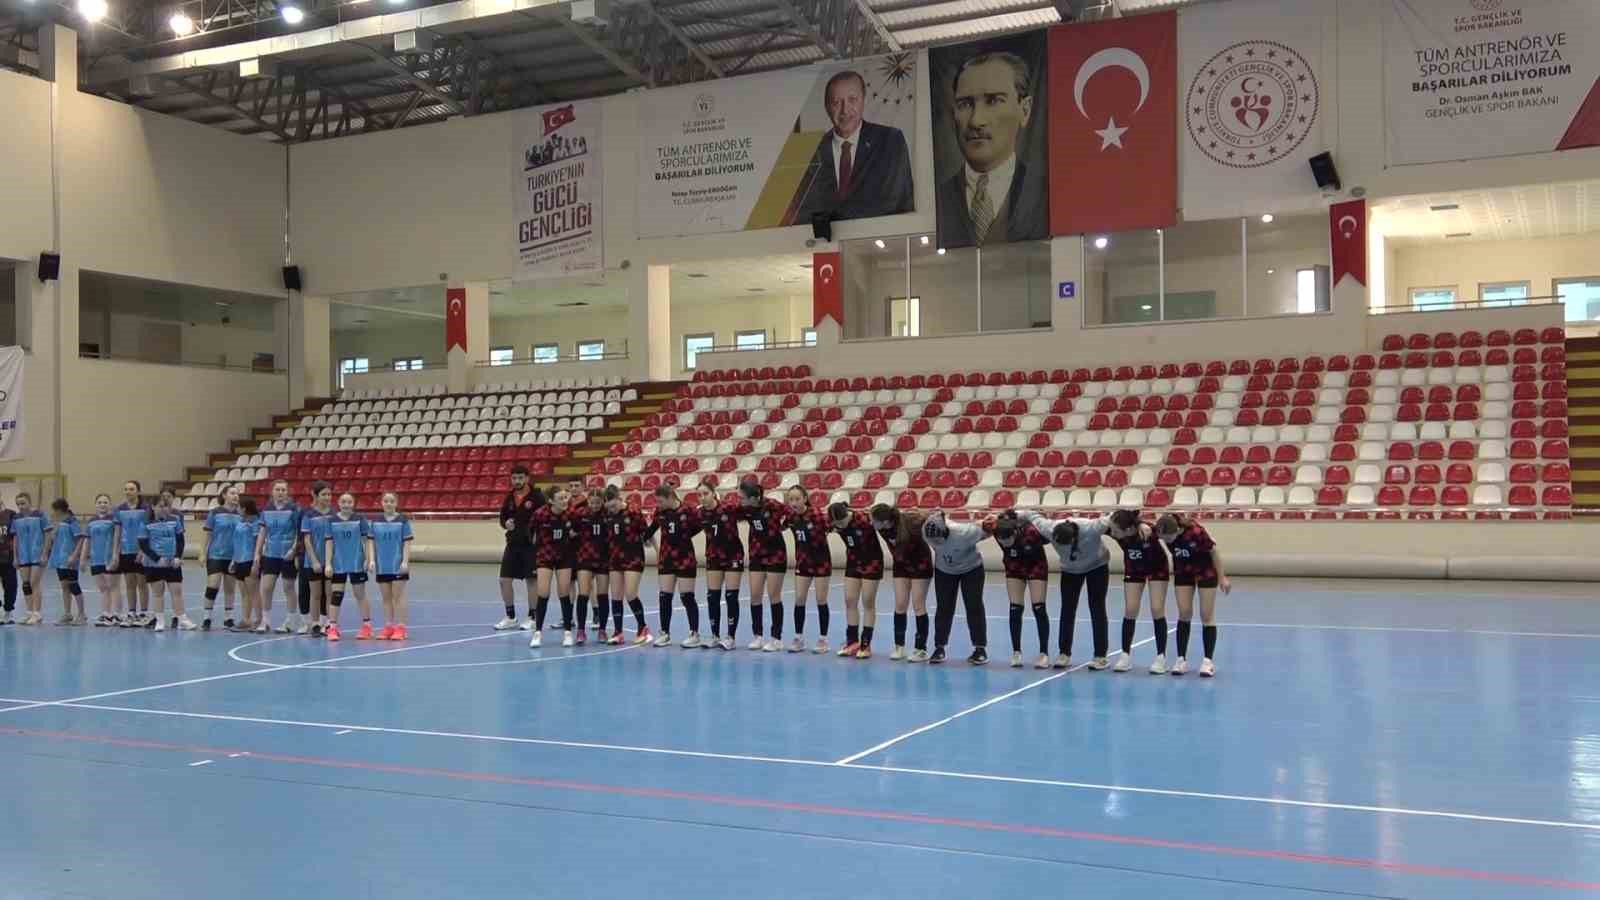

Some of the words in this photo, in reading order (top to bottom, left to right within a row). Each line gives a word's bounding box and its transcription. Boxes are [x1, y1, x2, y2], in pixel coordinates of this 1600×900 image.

[1416, 48, 1449, 63] TÜM
[1455, 36, 1542, 59] ANTRENÖR
[1546, 33, 1567, 47] VE
[1420, 49, 1562, 77] SPORCULARIMIZA
[1412, 75, 1488, 93] BAŞARILAR
[1491, 64, 1572, 84] DİLİYORUM
[1470, 105, 1483, 115] VE
[1487, 101, 1517, 112] SPOR
[657, 145, 679, 158] TÜM
[737, 137, 752, 148] VE
[660, 150, 749, 169] SPORCULARIMIZA
[534, 181, 577, 214] GÜCÜ
[668, 522, 675, 533] 3
[712, 525, 718, 537] 7
[1128, 549, 1143, 559] 22
